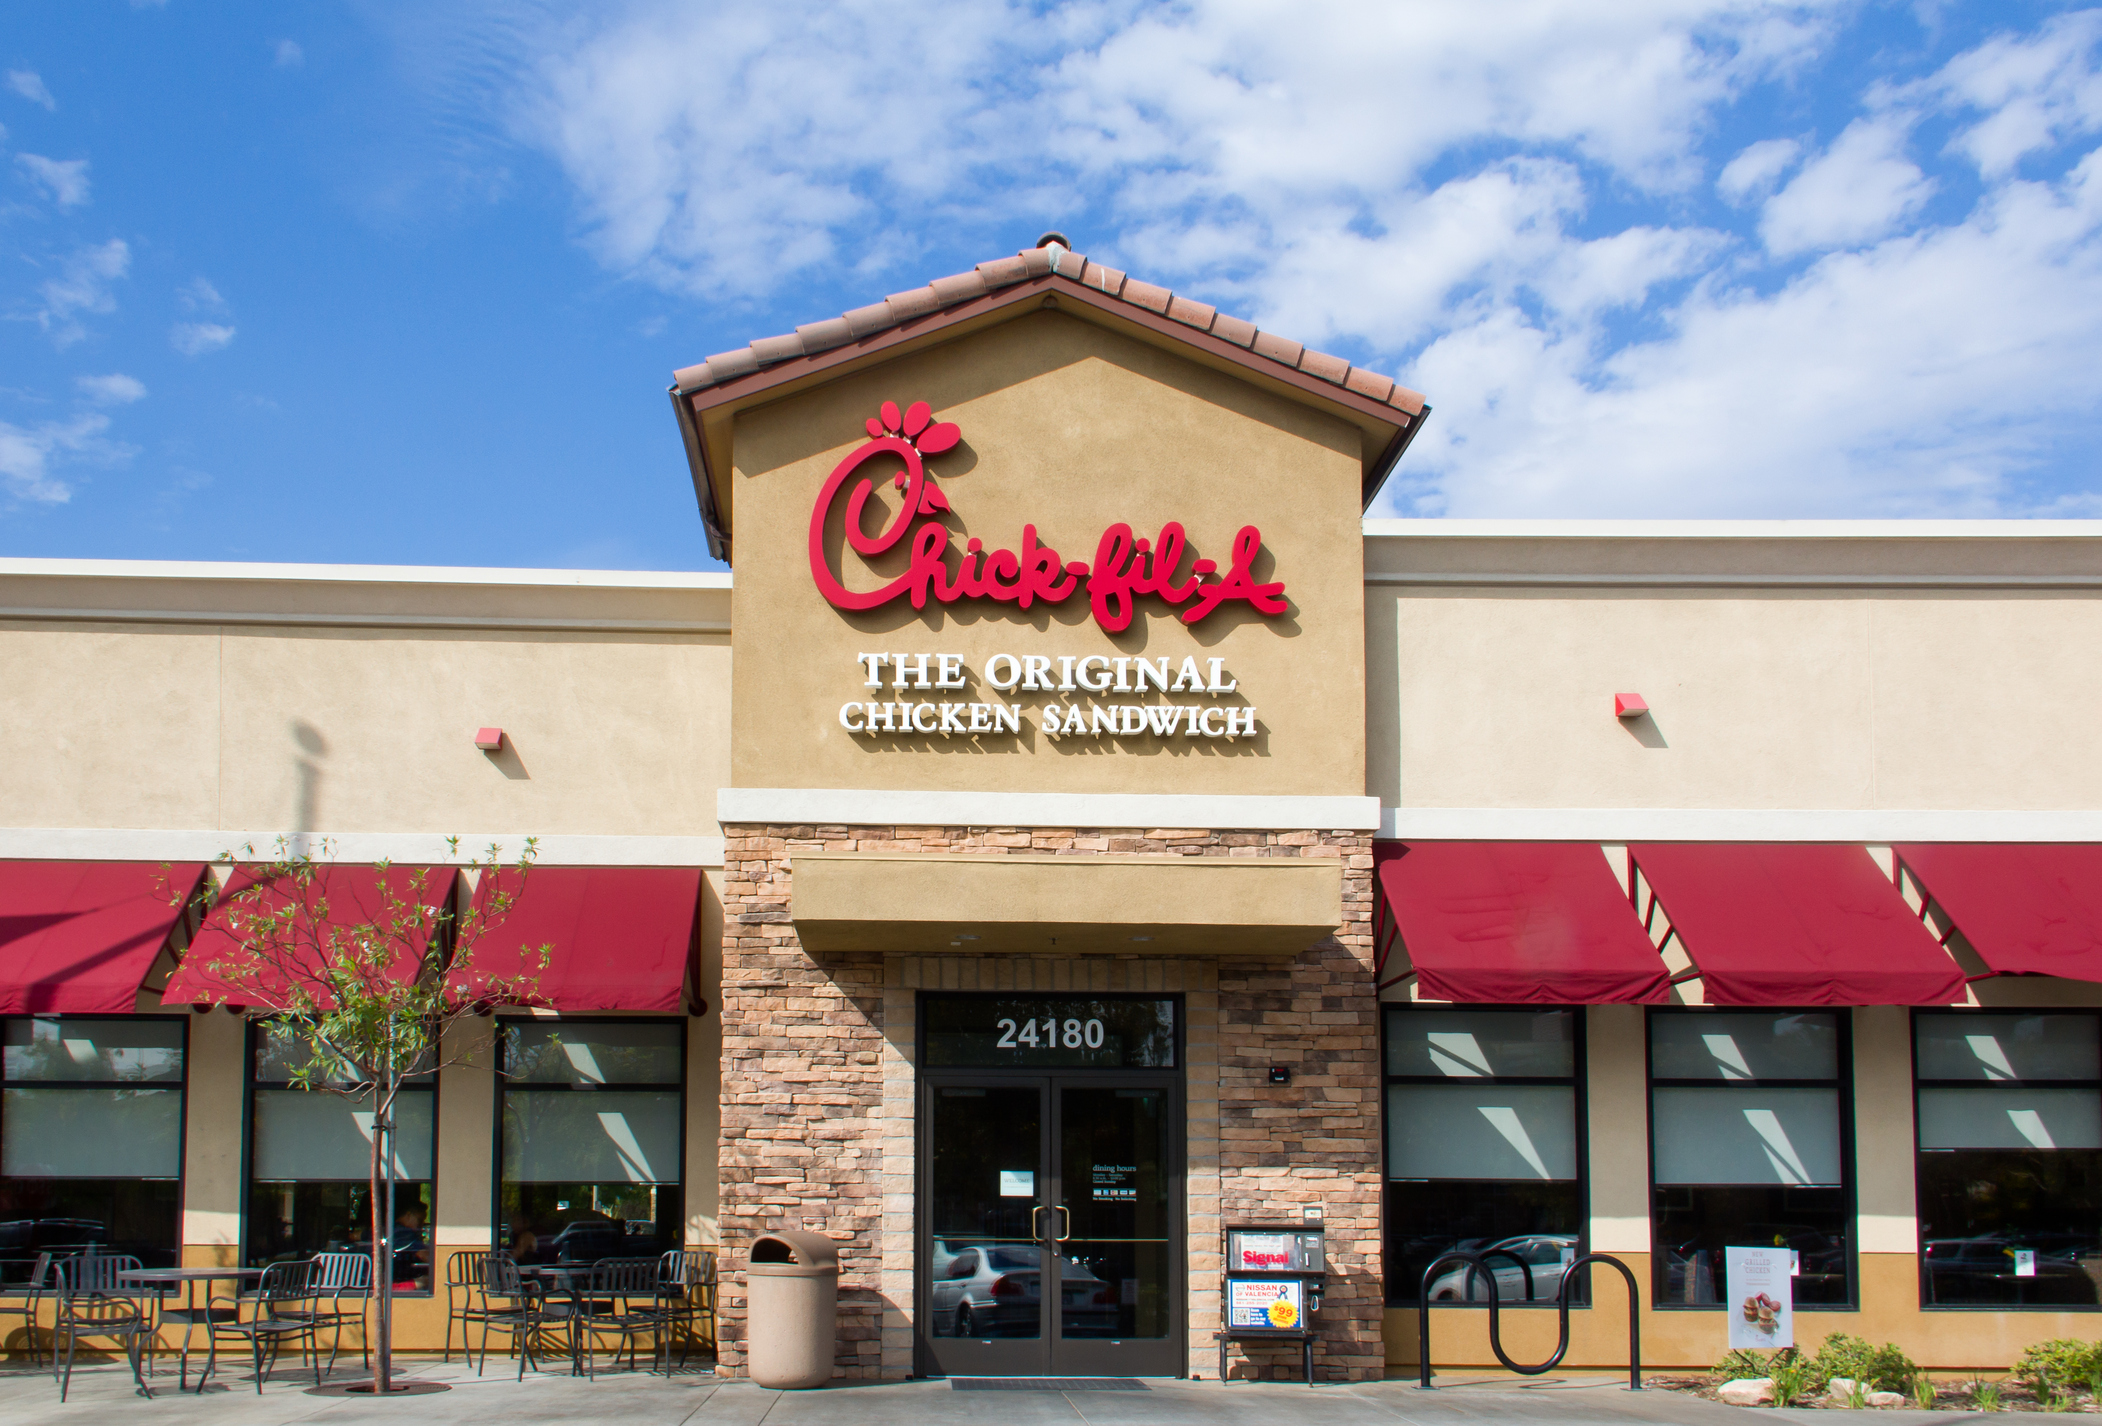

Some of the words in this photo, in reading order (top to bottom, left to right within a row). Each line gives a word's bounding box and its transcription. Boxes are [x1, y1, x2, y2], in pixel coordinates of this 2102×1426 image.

[809, 401, 1288, 634] Chick-fil-A
[857, 651, 966, 691] THE
[985, 653, 1238, 694] ORIGINAL
[839, 701, 1021, 735] CHICKEN
[1042, 704, 1257, 737] SANDWICH
[996, 1018, 1105, 1049] 24180
[1092, 1164, 1116, 1173] dining
[1116, 1164, 1137, 1172] hours
[1242, 1250, 1290, 1266] Signal
[1273, 1305, 1294, 1318] $99
